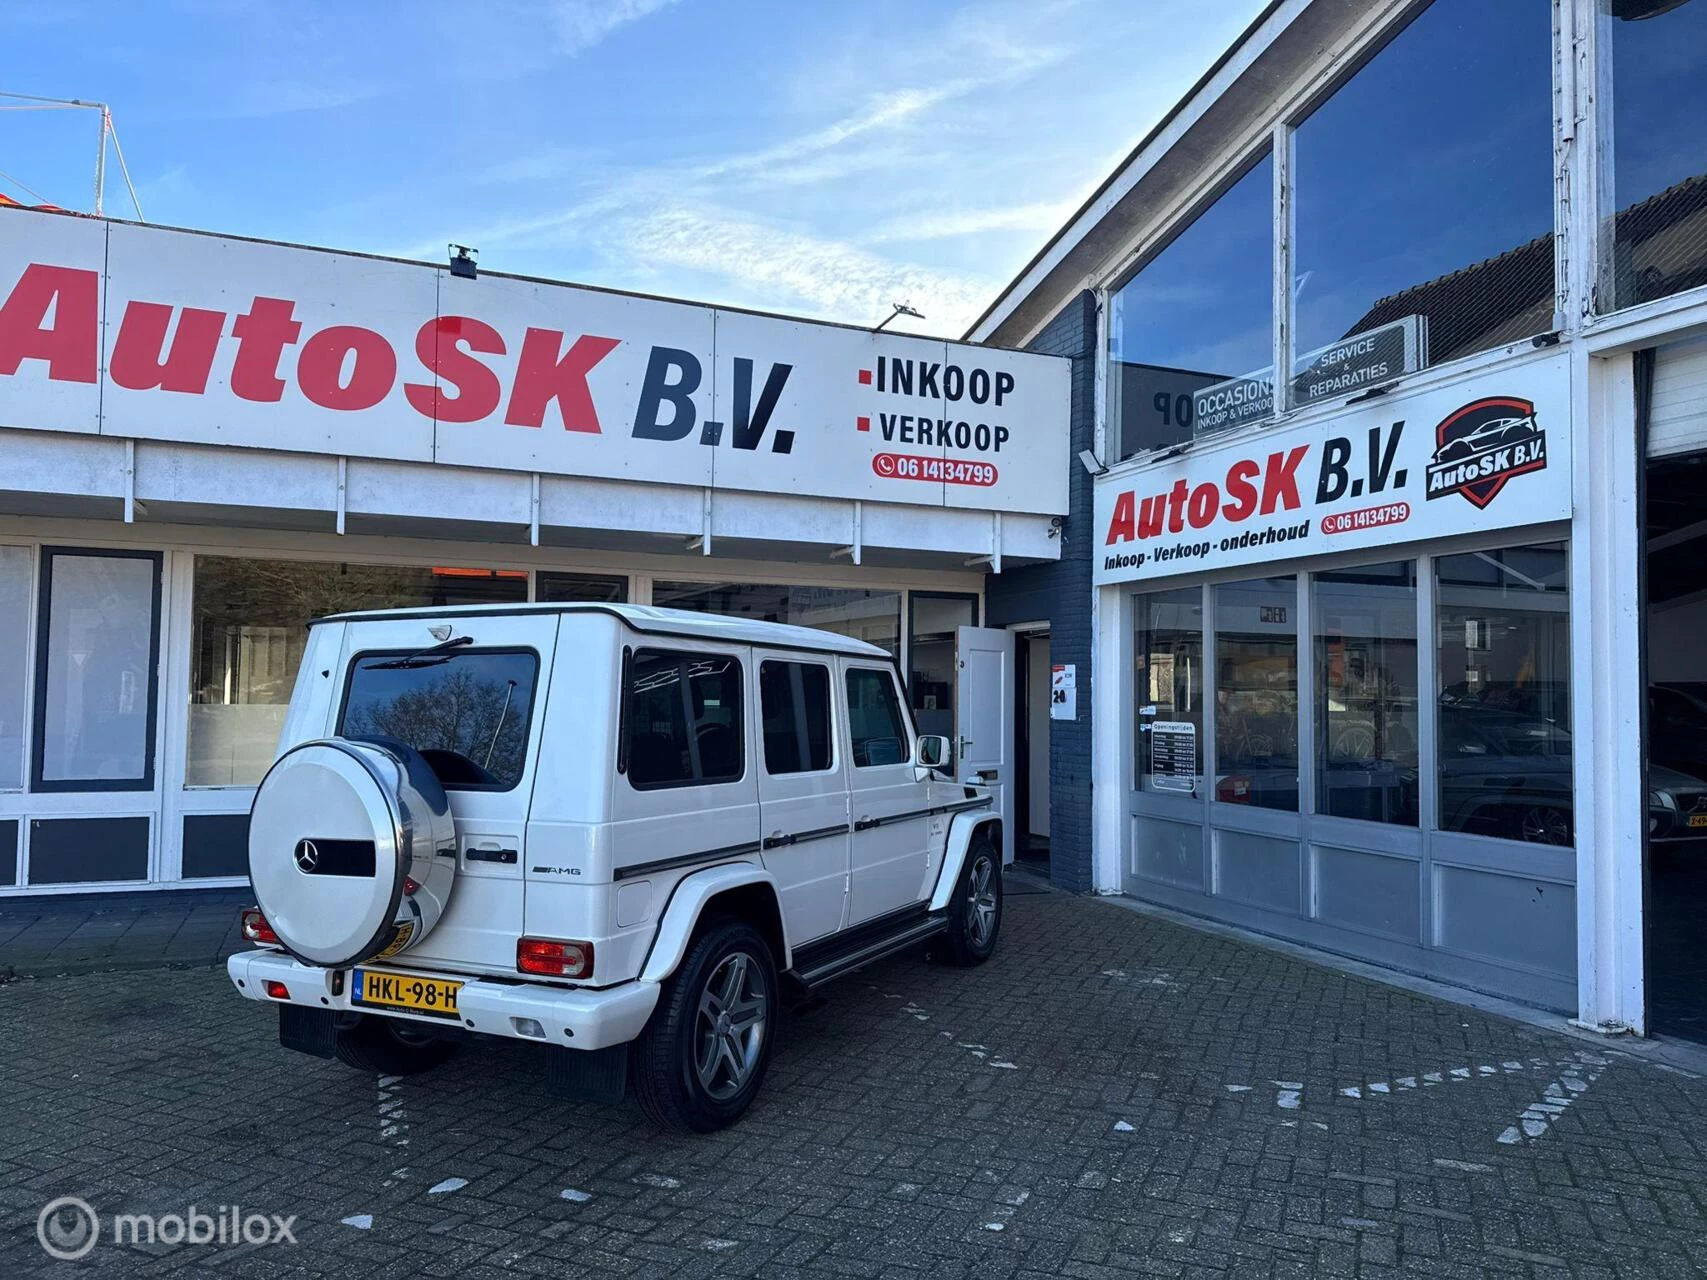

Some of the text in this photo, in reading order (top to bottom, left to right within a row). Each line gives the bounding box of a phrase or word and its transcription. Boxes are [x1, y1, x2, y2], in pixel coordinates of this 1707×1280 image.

[0, 264, 796, 455] AutoSK B.V.
[1321, 338, 1375, 367] SERVICE
[1343, 362, 1350, 371] &
[877, 355, 1015, 407] INKOOP
[1309, 362, 1388, 398] REPARATIES
[1197, 397, 1273, 430] INKOOP & VERKOO
[879, 412, 1010, 453] VERKOOP
[897, 457, 993, 483] 06 14134799
[1429, 438, 1544, 492] AutoSK B.V.
[1106, 420, 1408, 545] AutoSK B.V.
[1337, 504, 1407, 530] 06 14134799
[1104, 552, 1145, 570] Inkoop
[1154, 541, 1210, 562] Verkoop
[1220, 520, 1310, 551] onderhoud
[1053, 689, 1066, 704] 20
[548, 867, 581, 875] AMG
[368, 975, 458, 1009] HKL-98-H
